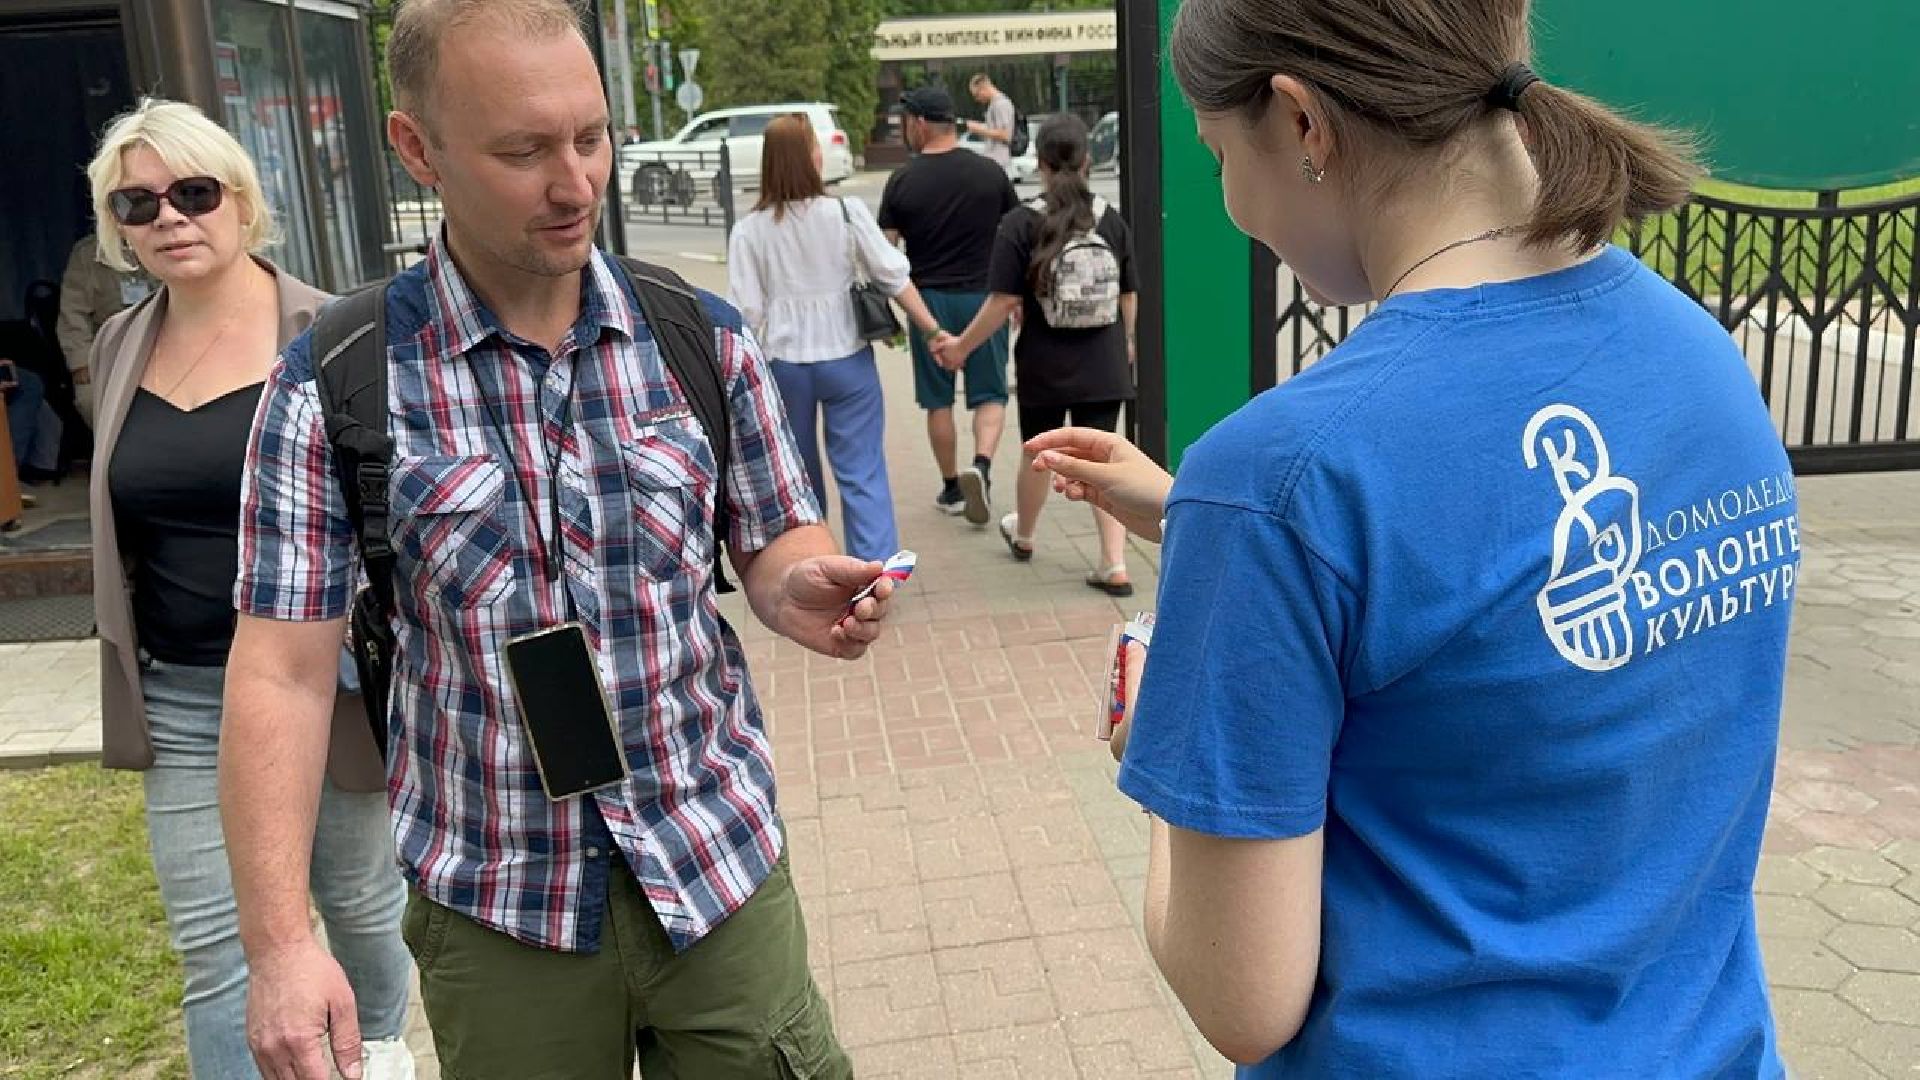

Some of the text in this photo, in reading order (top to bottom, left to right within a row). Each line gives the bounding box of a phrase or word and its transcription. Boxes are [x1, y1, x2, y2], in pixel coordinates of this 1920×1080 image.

[926, 29, 1000, 47] КОМПЛЕКС
[1005, 26, 1073, 44] МИНФИНА
[1632, 515, 1800, 610] ВОЛОНТЕ
